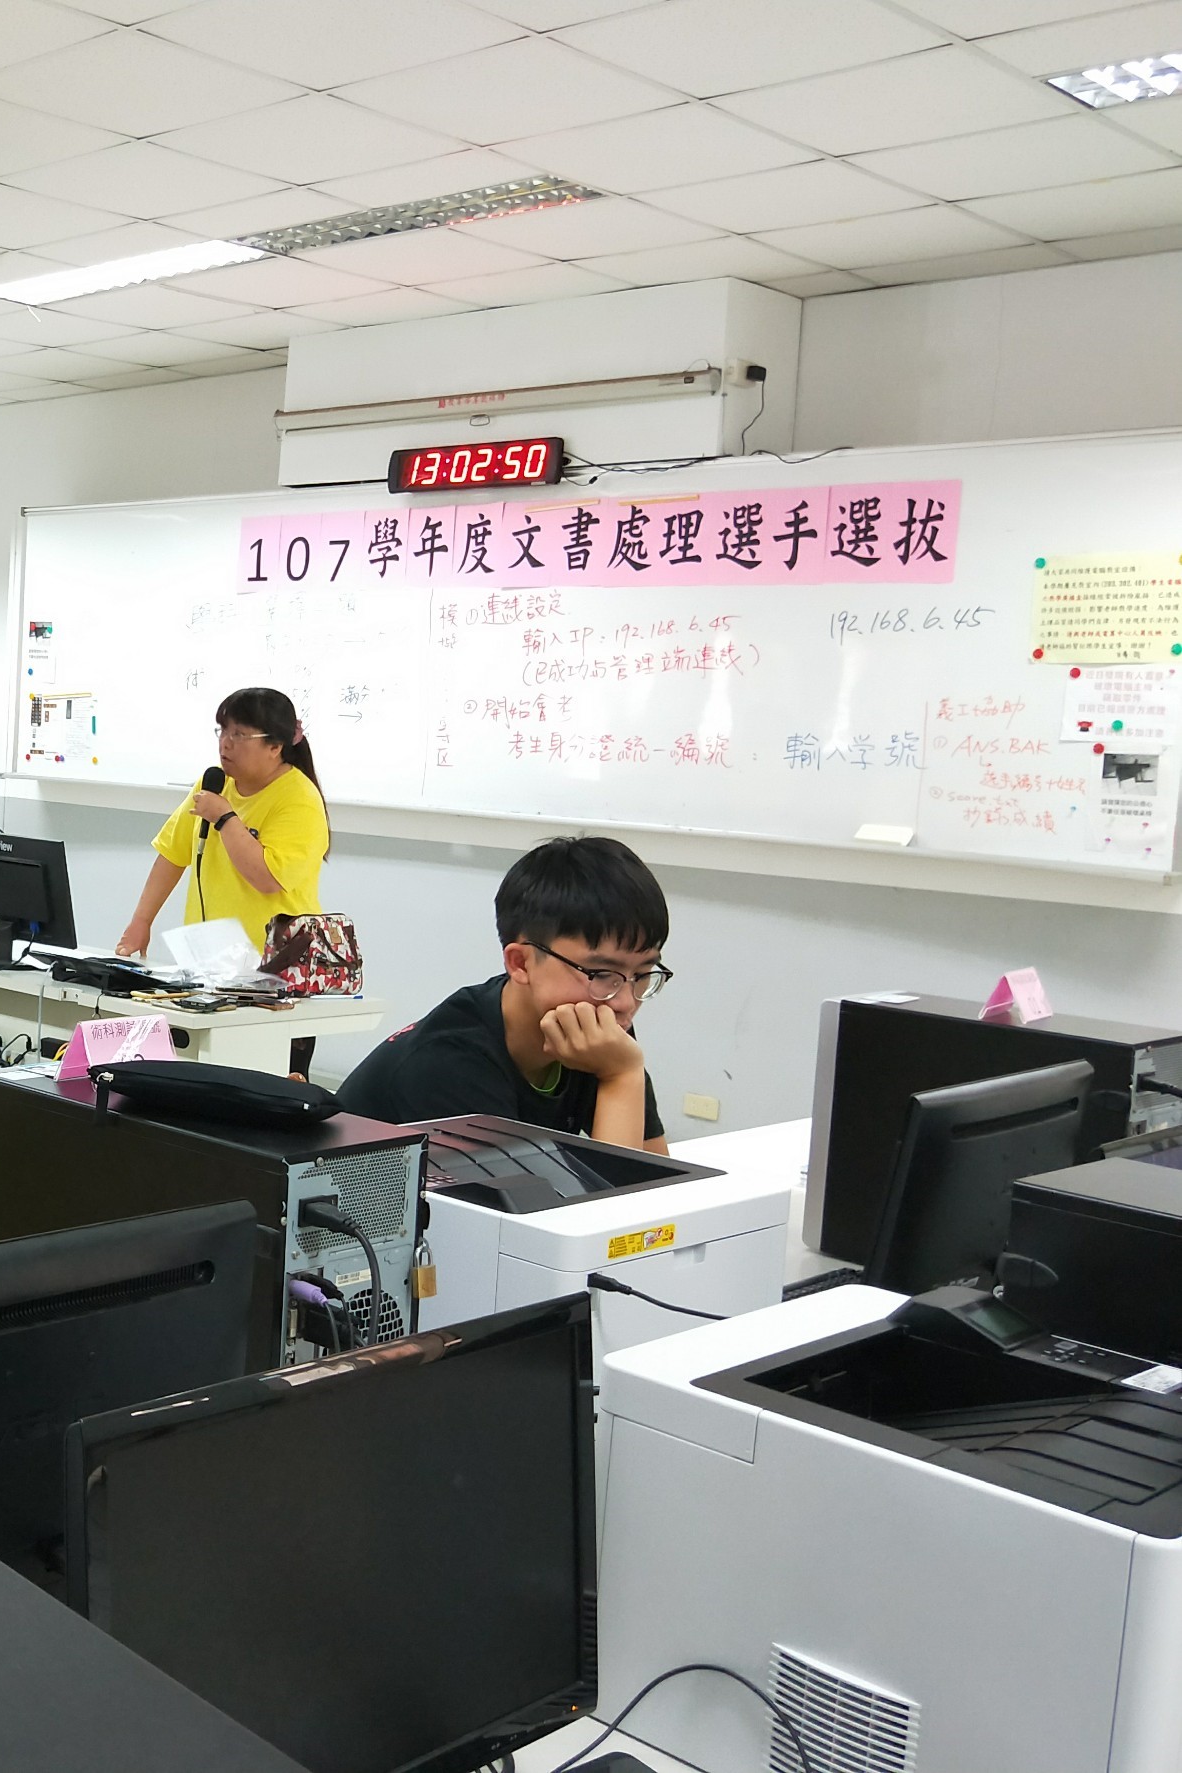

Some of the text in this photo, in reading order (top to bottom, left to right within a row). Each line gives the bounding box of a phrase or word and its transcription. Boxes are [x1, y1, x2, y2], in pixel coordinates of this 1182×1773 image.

[411, 444, 546, 485] 13:02:50
[246, 497, 949, 582] 107學年度文書處理選手選拔
[830, 606, 995, 645] 192.168.6.45
